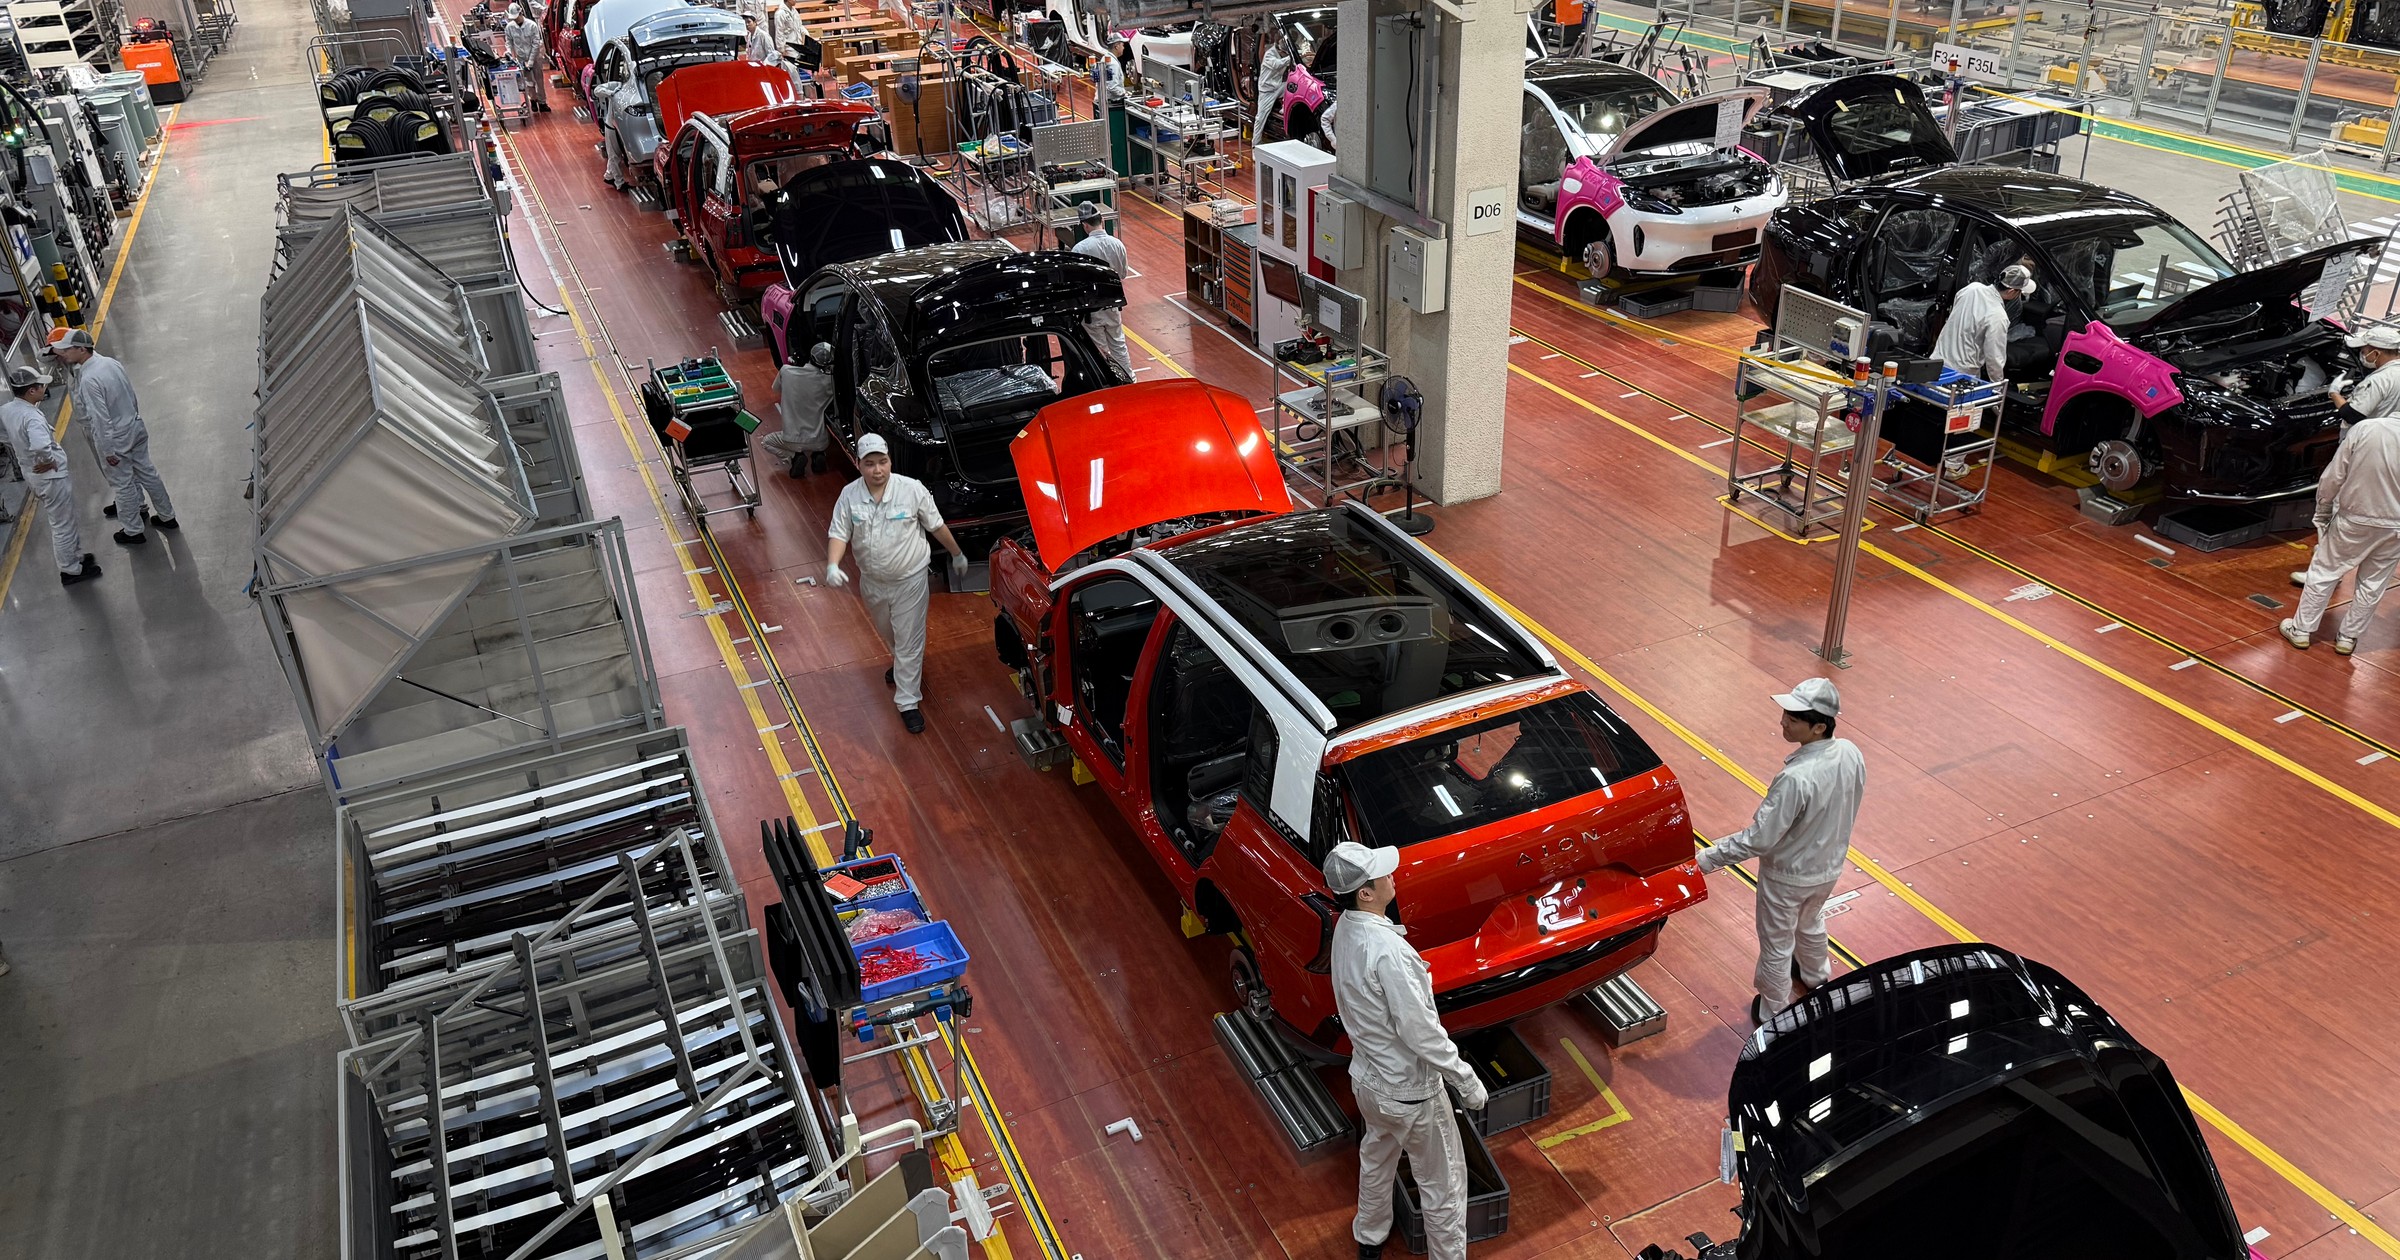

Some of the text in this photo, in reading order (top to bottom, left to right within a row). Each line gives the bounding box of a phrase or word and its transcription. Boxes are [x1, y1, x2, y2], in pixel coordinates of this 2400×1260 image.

[1967, 57, 1996, 75] F35L
[1474, 202, 1501, 220] D06
[1516, 828, 1601, 868] AION
